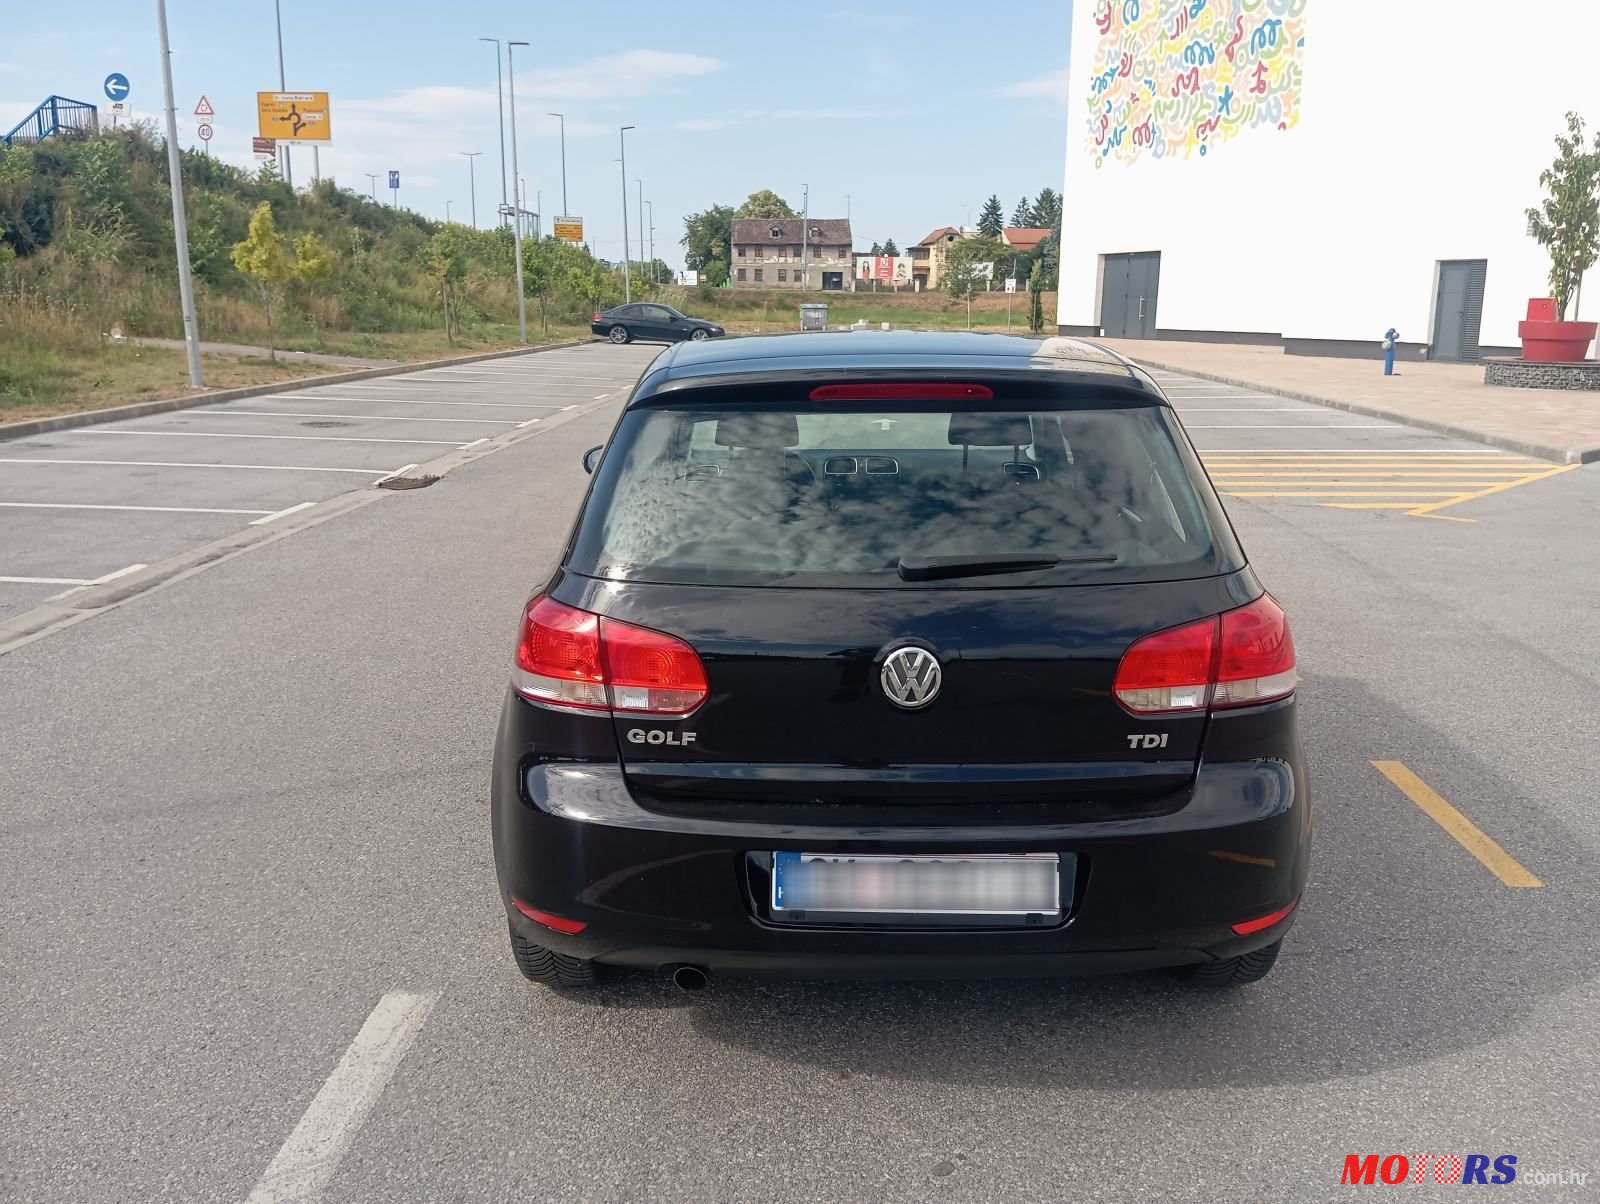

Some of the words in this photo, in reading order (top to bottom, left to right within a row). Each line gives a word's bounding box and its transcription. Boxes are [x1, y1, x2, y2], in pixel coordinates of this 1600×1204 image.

[201, 128, 210, 136] 40
[881, 647, 941, 706] VW
[627, 728, 697, 746] GOLF
[1127, 733, 1169, 749] TDI
